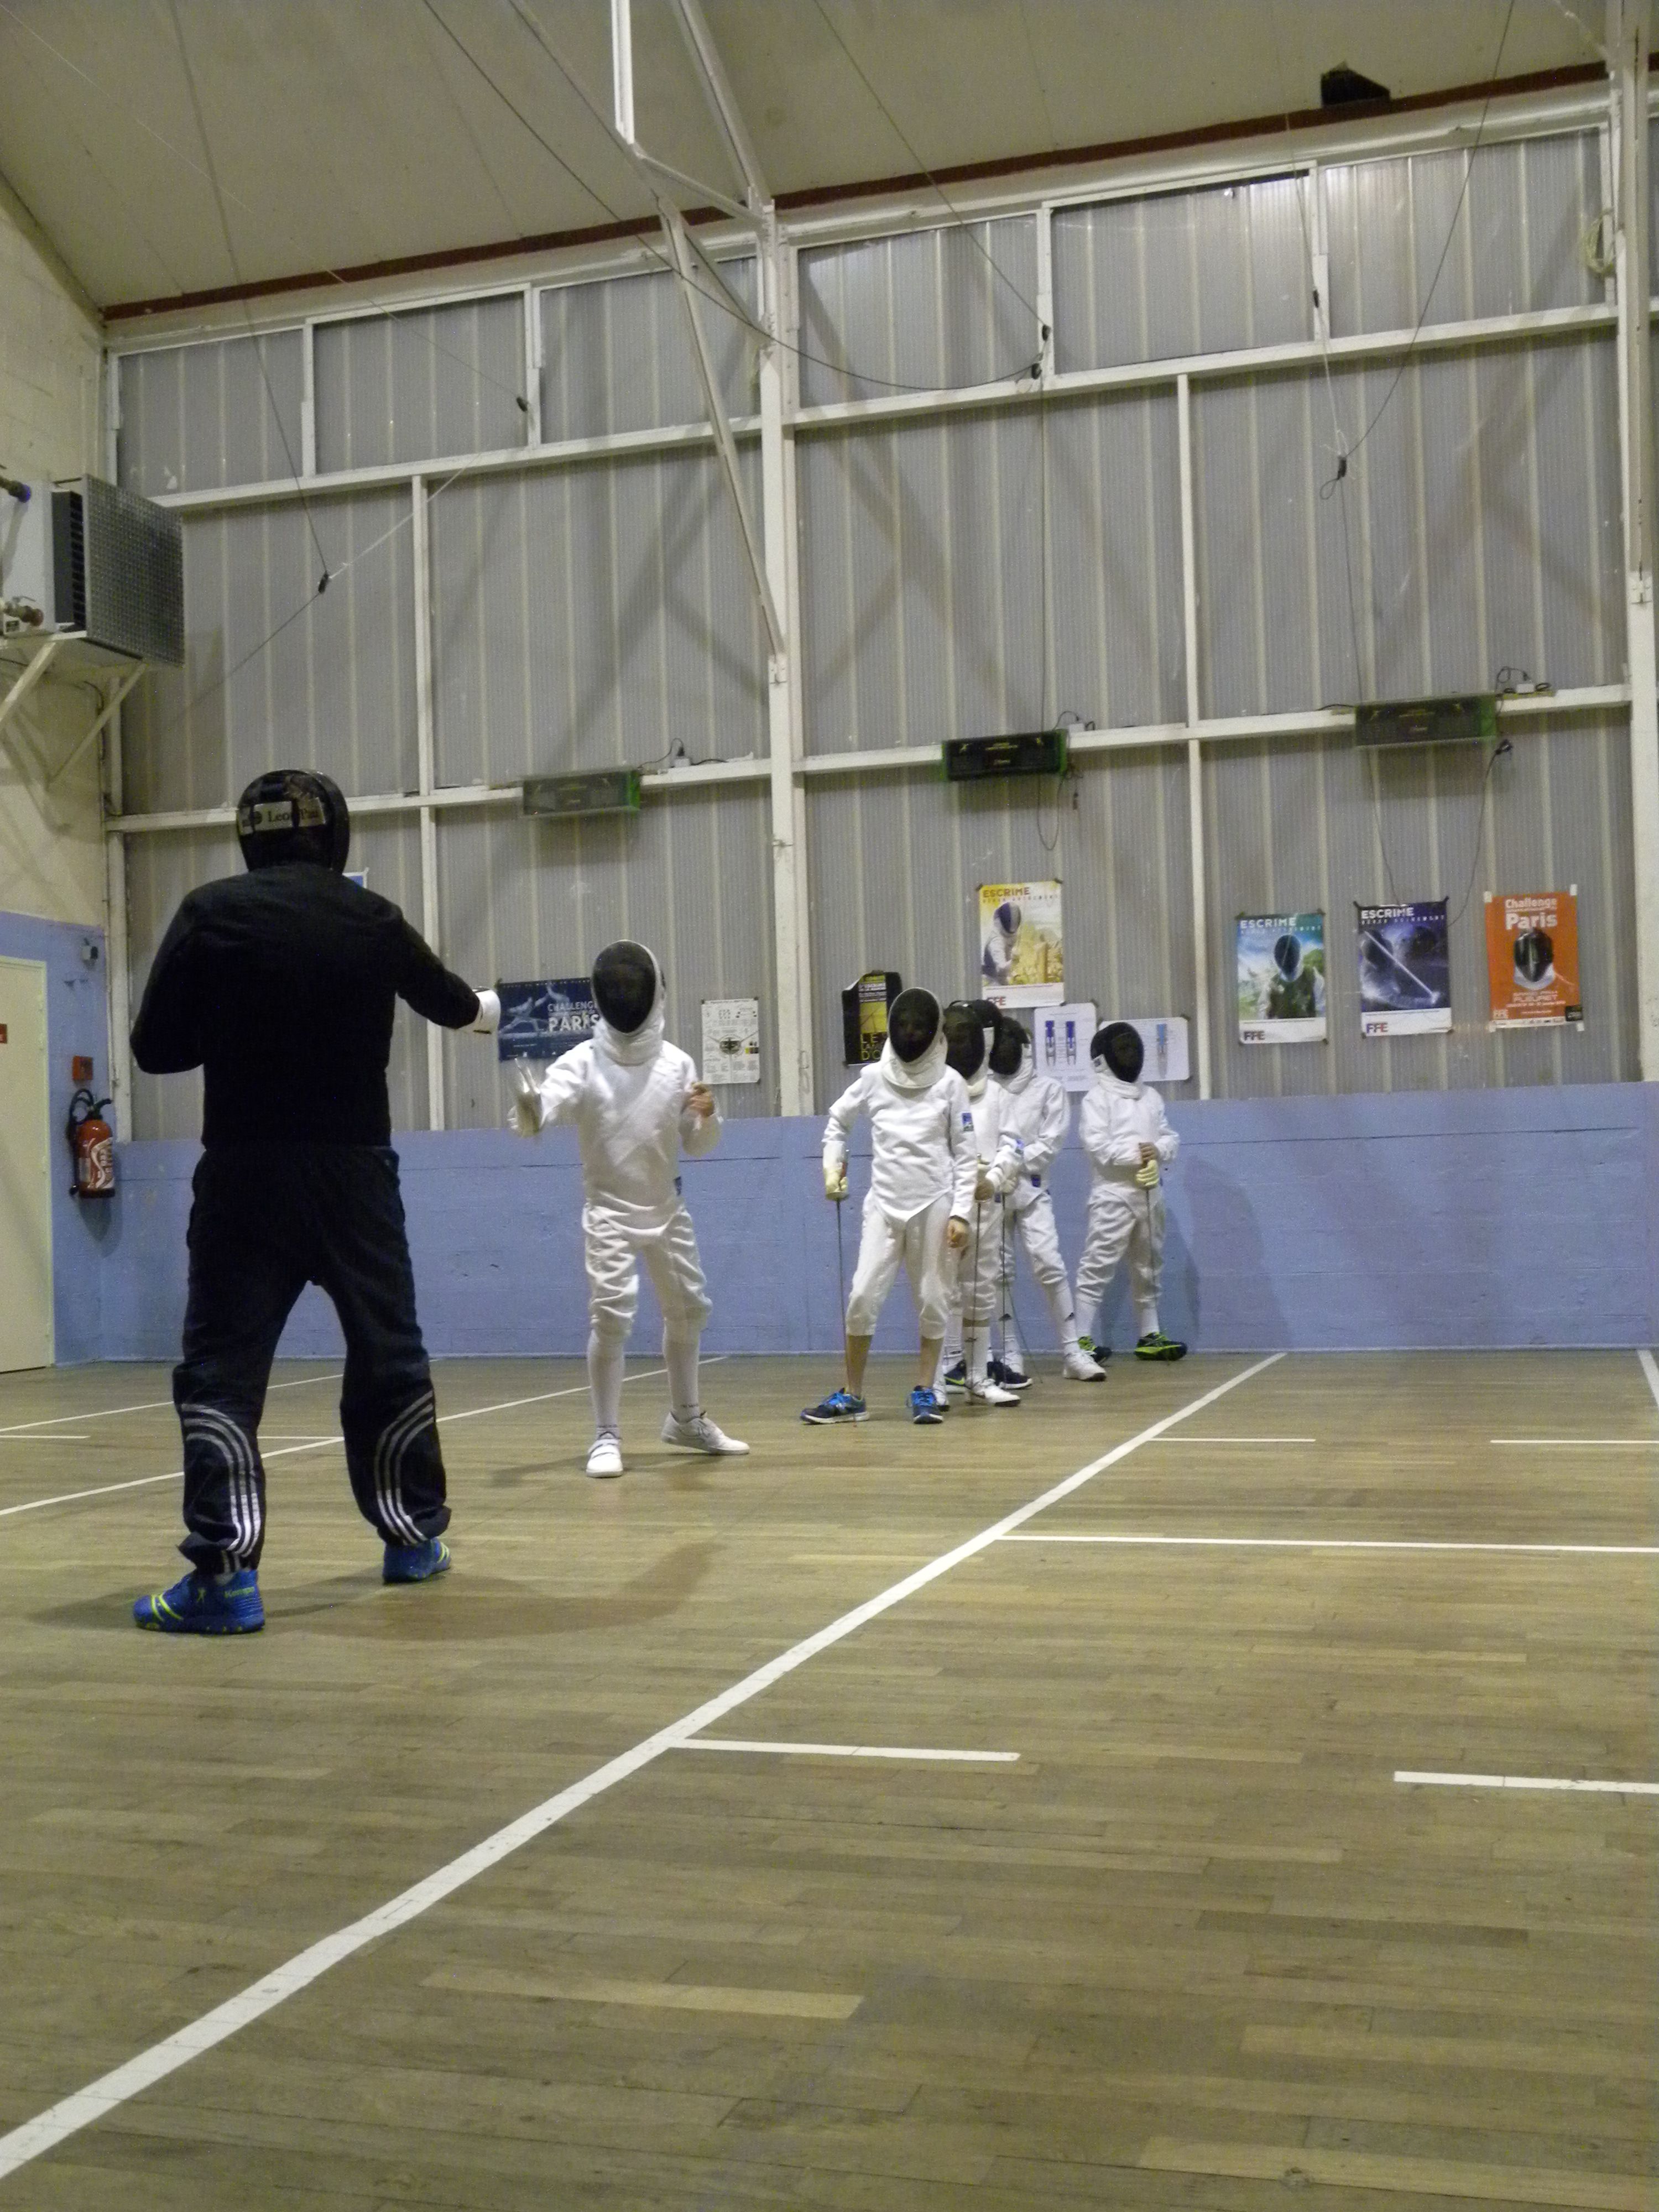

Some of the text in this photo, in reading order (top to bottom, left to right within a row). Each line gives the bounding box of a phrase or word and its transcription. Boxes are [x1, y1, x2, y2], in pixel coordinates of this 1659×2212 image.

[268, 811, 293, 822] Leo
[983, 886, 1030, 898] ESCRIME
[1505, 898, 1557, 909] Challenge
[1360, 907, 1415, 919] ESCRIME
[1240, 917, 1297, 929] ESCRIME
[1505, 912, 1558, 930] Paris
[547, 1000, 595, 1012] CHALLENG
[548, 1013, 600, 1032] PARIS
[1366, 1022, 1389, 1034] FFE
[1243, 1030, 1265, 1041] FFE
